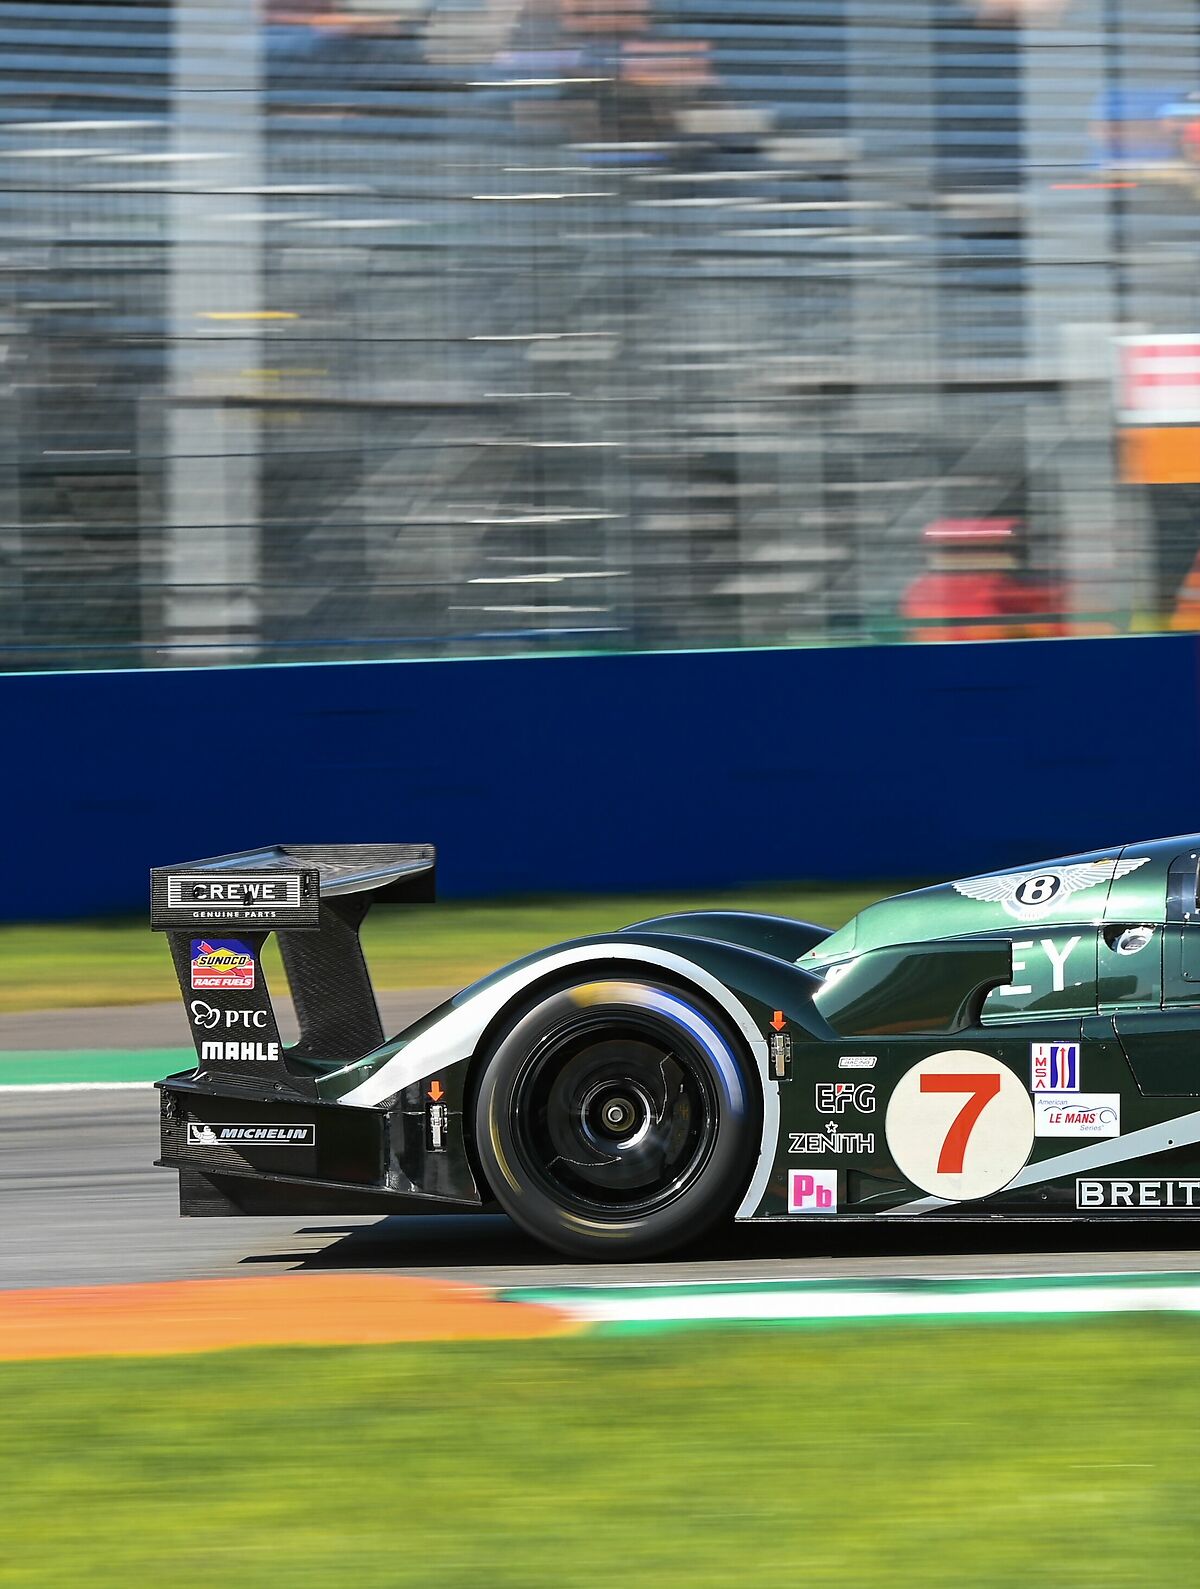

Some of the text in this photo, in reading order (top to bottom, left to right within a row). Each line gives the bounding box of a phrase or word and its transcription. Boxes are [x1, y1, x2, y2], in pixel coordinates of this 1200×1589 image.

[192, 884, 276, 899] CREWE
[1020, 875, 1056, 904] B
[199, 956, 247, 965] SUNOCO
[987, 935, 1082, 996] EY
[224, 1010, 268, 1028] PTC
[201, 1041, 279, 1061] MAHLE
[1035, 1046, 1047, 1088] IMSA
[815, 1083, 876, 1113] EFG
[920, 1074, 1000, 1173] 7
[1049, 1113, 1096, 1124] LE MANS
[1080, 1124, 1102, 1132] Series
[220, 1128, 308, 1139] MICHELIN
[788, 1133, 875, 1153] ZENITH
[793, 1174, 832, 1208] Pb
